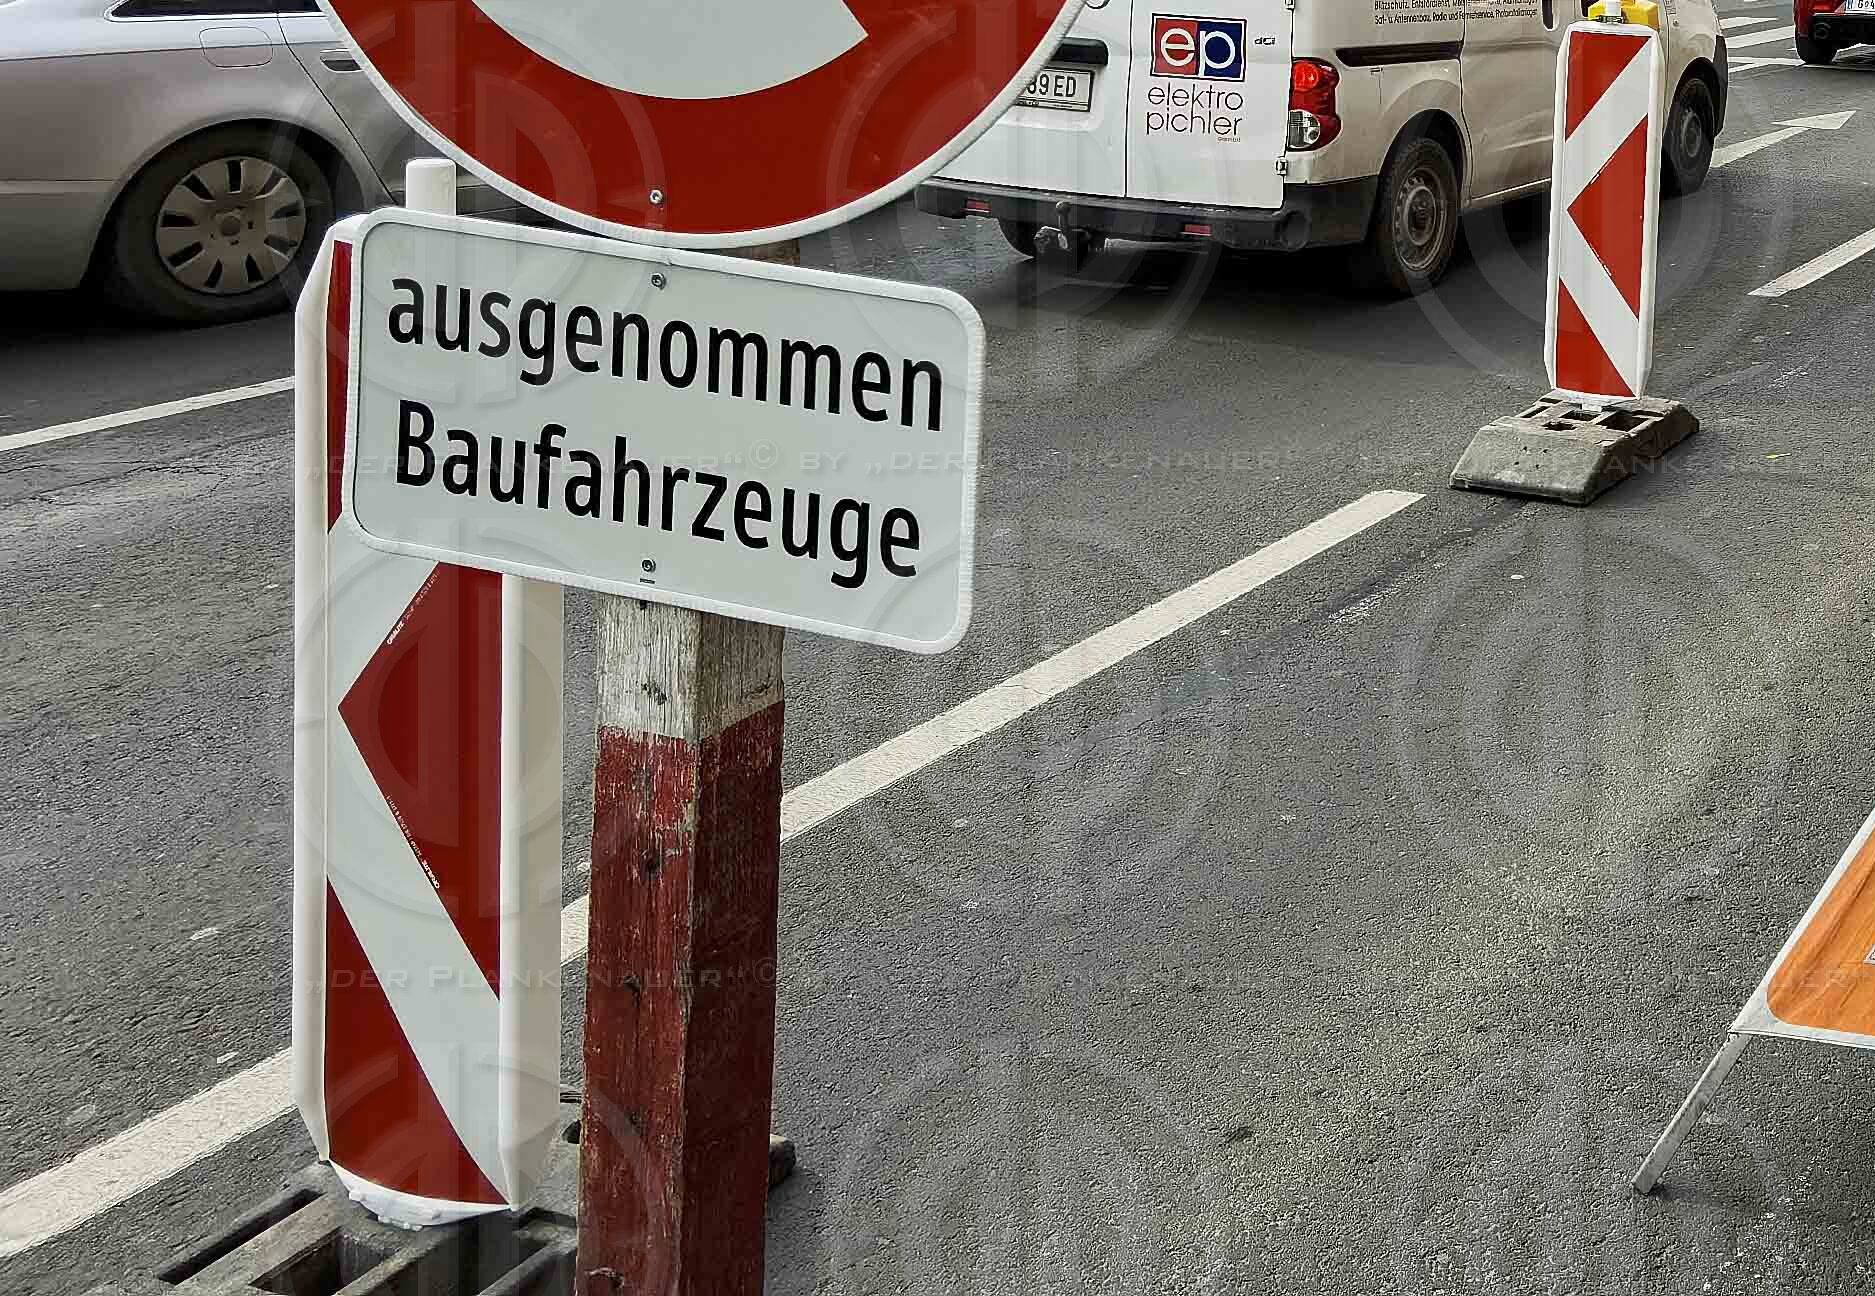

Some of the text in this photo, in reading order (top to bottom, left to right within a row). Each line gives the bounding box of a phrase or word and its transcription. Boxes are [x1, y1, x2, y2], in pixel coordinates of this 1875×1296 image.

[1146, 106, 1243, 136] pichler
[1148, 81, 1244, 111] elektro
[388, 278, 942, 432] ausgenommen
[396, 399, 920, 589] Baufahrzeuge
